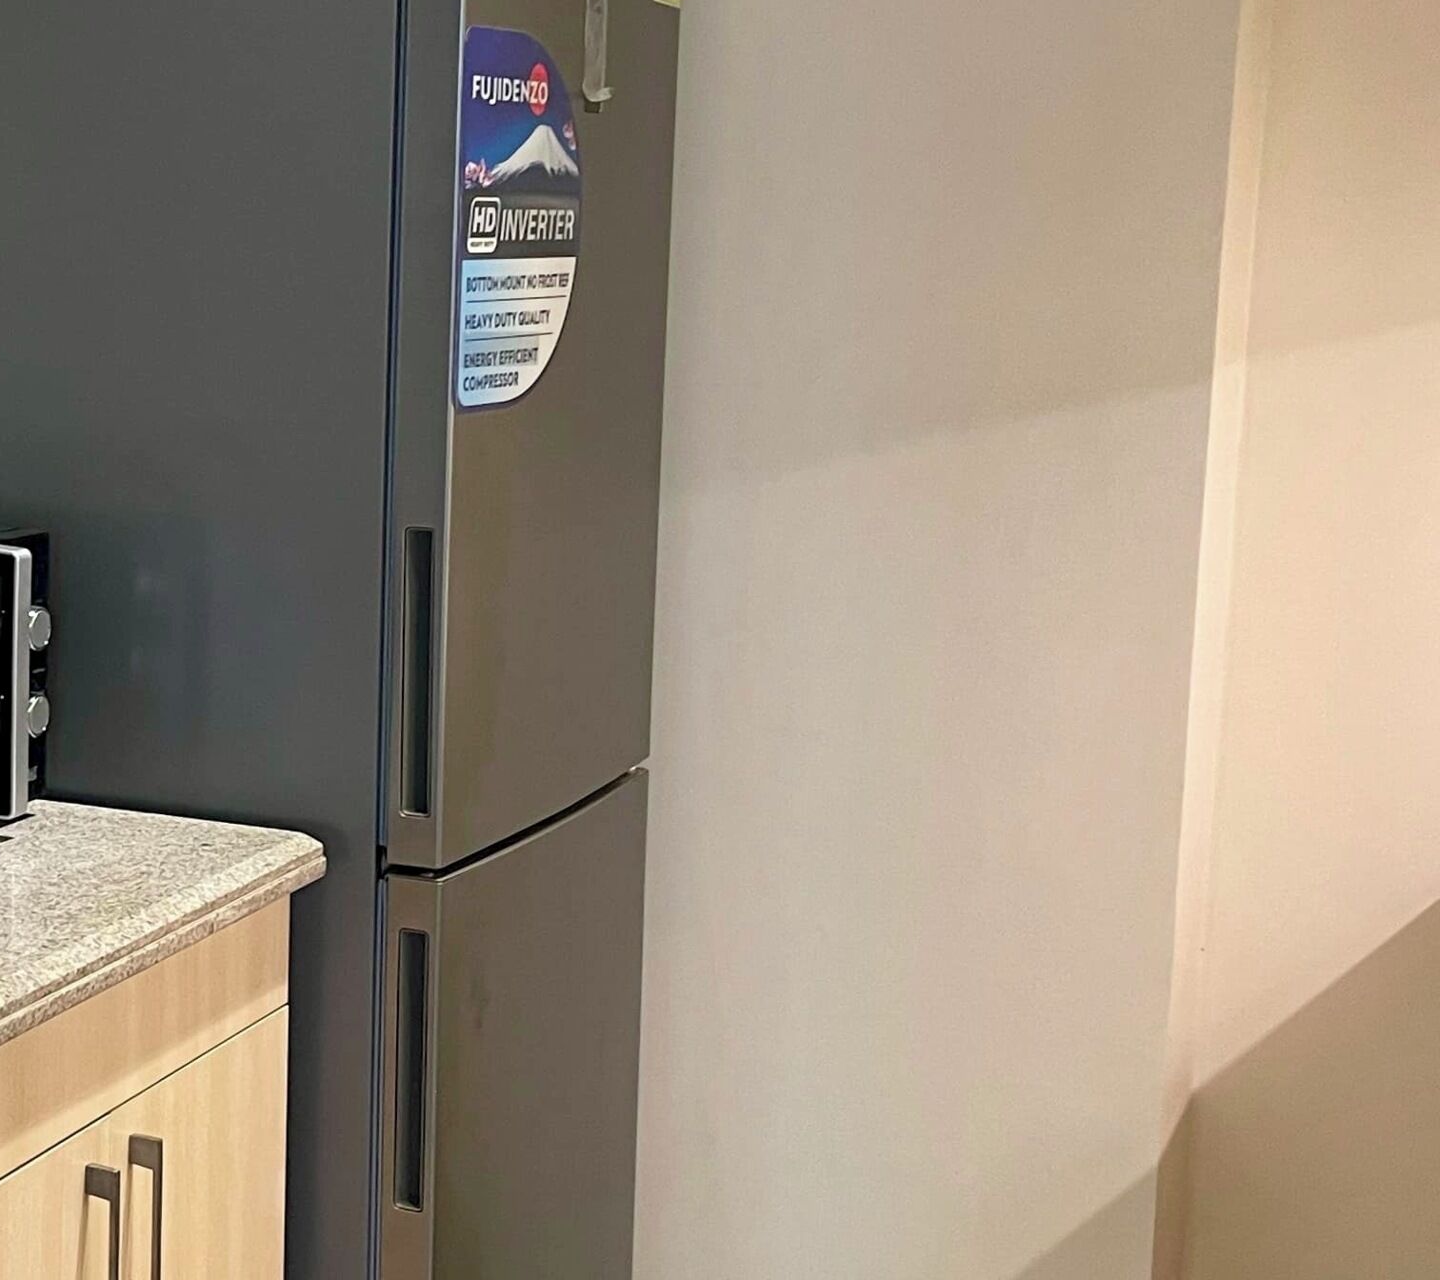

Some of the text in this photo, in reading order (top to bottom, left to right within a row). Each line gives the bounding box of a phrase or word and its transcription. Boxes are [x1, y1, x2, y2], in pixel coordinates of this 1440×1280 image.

[472, 74, 548, 105] FUJIDENZO
[472, 206, 496, 233] HD
[500, 208, 575, 241] INVERTER
[466, 276, 501, 293] BOTTOM
[501, 275, 526, 291] MOUNT
[527, 274, 537, 289] NO
[538, 273, 558, 288] FROST
[464, 309, 551, 329] HEAVY DUTY QUALITY
[464, 347, 539, 368] ENERGY EFFICIENT
[463, 371, 519, 391] COMPRESSOR
